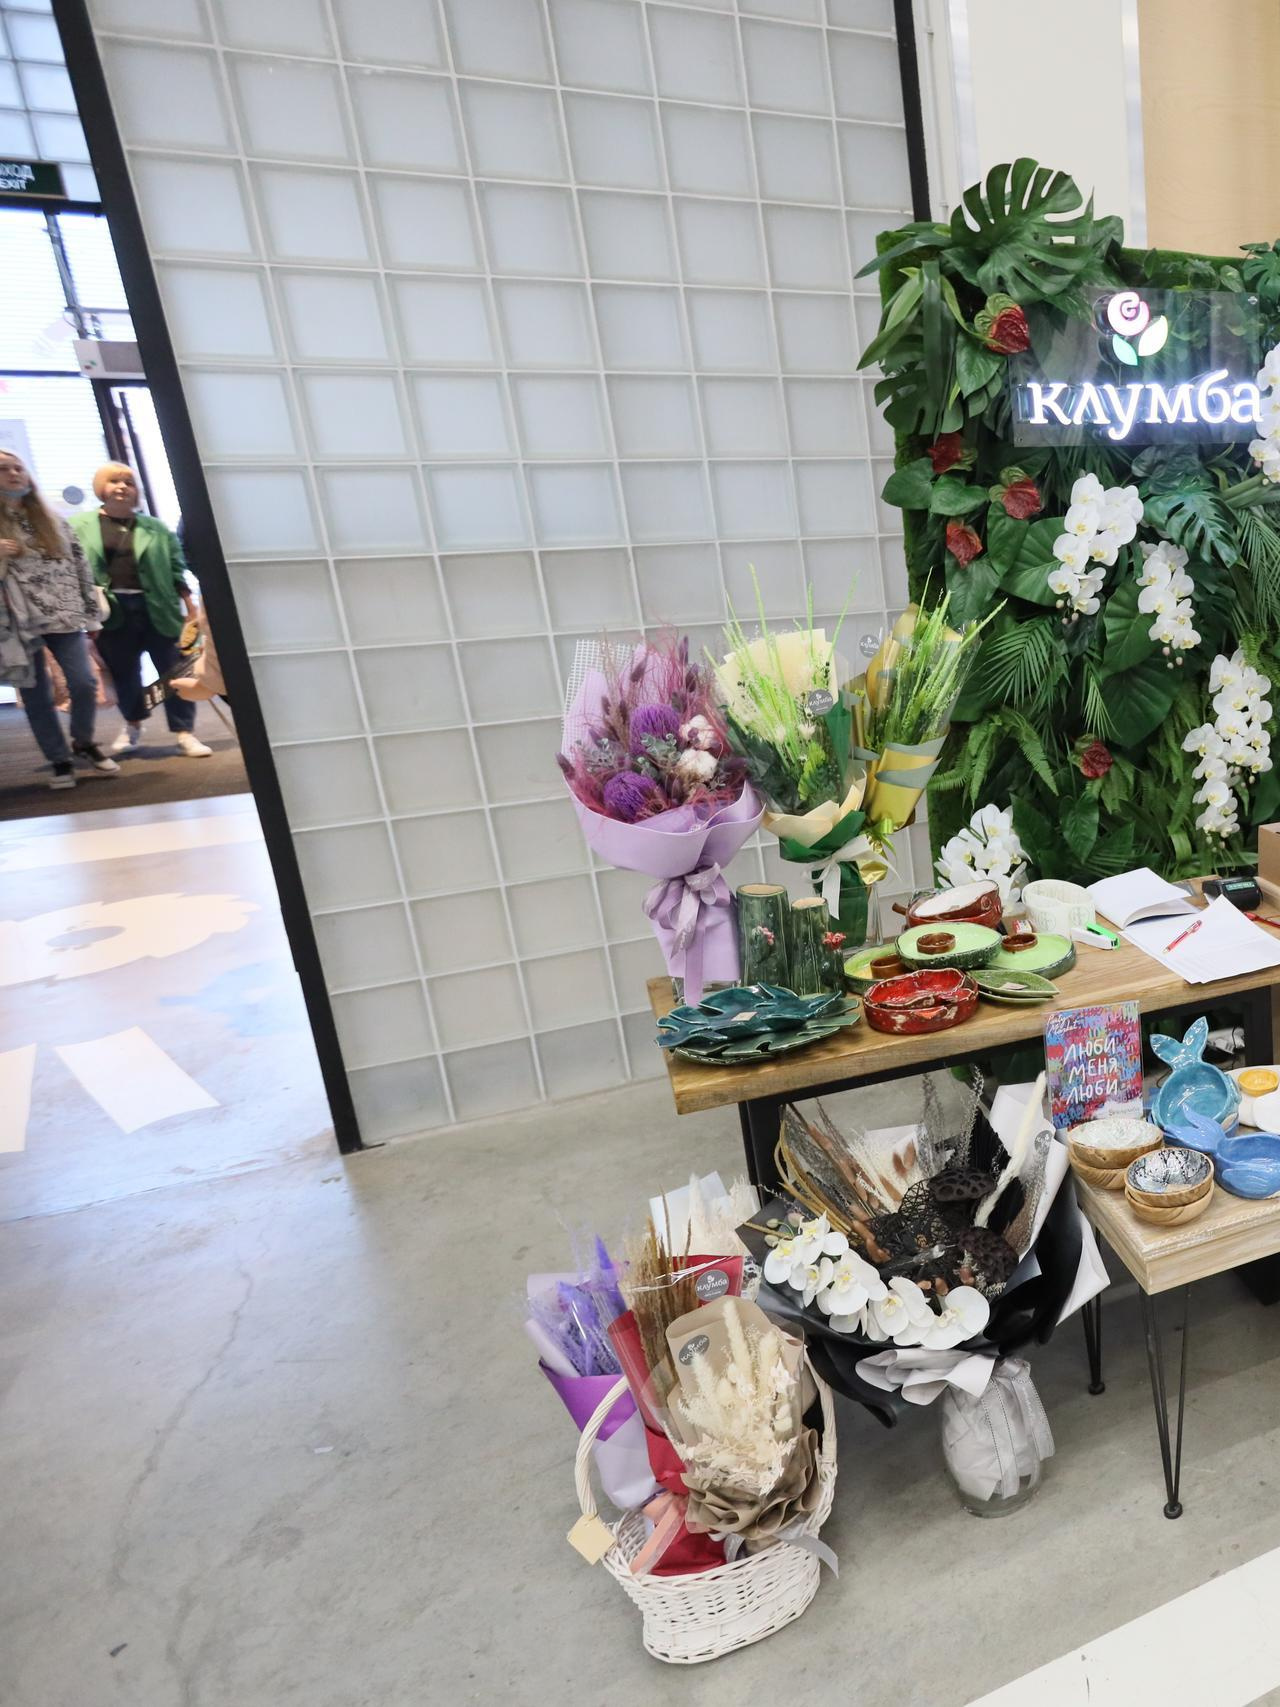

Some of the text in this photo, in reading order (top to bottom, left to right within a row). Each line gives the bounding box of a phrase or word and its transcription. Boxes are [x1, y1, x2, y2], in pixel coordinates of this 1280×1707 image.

[1027, 369, 1262, 440] клумба
[1063, 1037, 1117, 1068] ЛЮБИ
[1068, 1057, 1118, 1084] МЕНЯ
[1065, 1078, 1118, 1106] ЛЮБИ
